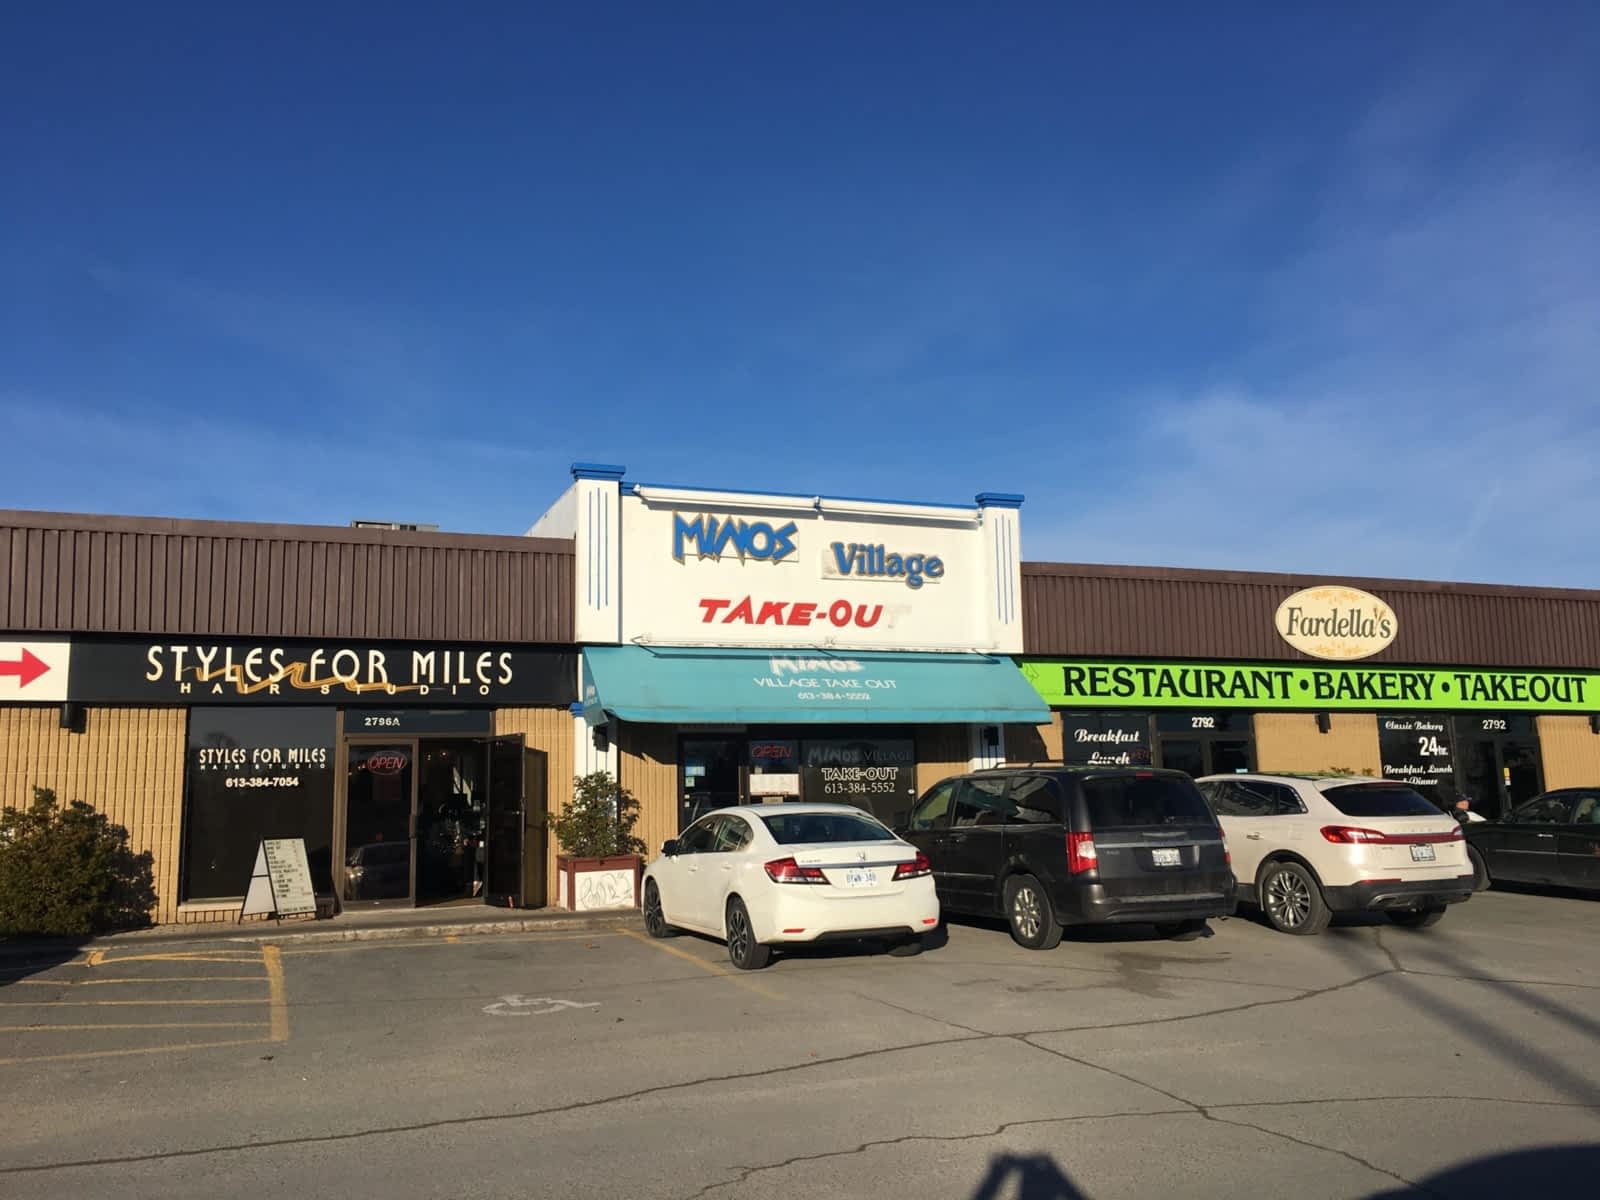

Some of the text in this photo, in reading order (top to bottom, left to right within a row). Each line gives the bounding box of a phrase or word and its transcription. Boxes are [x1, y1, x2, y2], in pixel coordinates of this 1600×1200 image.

[672, 510, 798, 565] MINOS
[830, 541, 945, 589] Village
[1286, 606, 1391, 639] Fardella's
[146, 645, 512, 685] STYLES FOR MILES
[180, 682, 490, 695] HAIR STUDIO
[753, 677, 897, 688] VILLAGE TAKE OUT
[1062, 666, 1587, 703] RESTAURANT BAKERY TAKEOUT
[364, 717, 400, 726] 2796A
[1191, 717, 1214, 728] 2792
[1385, 720, 1443, 732] Classic Bakery
[1482, 719, 1506, 730] 2792
[1074, 728, 1140, 744] Breakfast
[199, 748, 326, 764] STYLES FOR MILES
[752, 745, 793, 759] OPEN
[369, 756, 404, 769] OPEN
[1427, 764, 1453, 774] Lunch
[821, 767, 899, 781] TAKE-OUT
[225, 777, 299, 788] 613-384-7054
[824, 782, 895, 793] 613-384-5552
